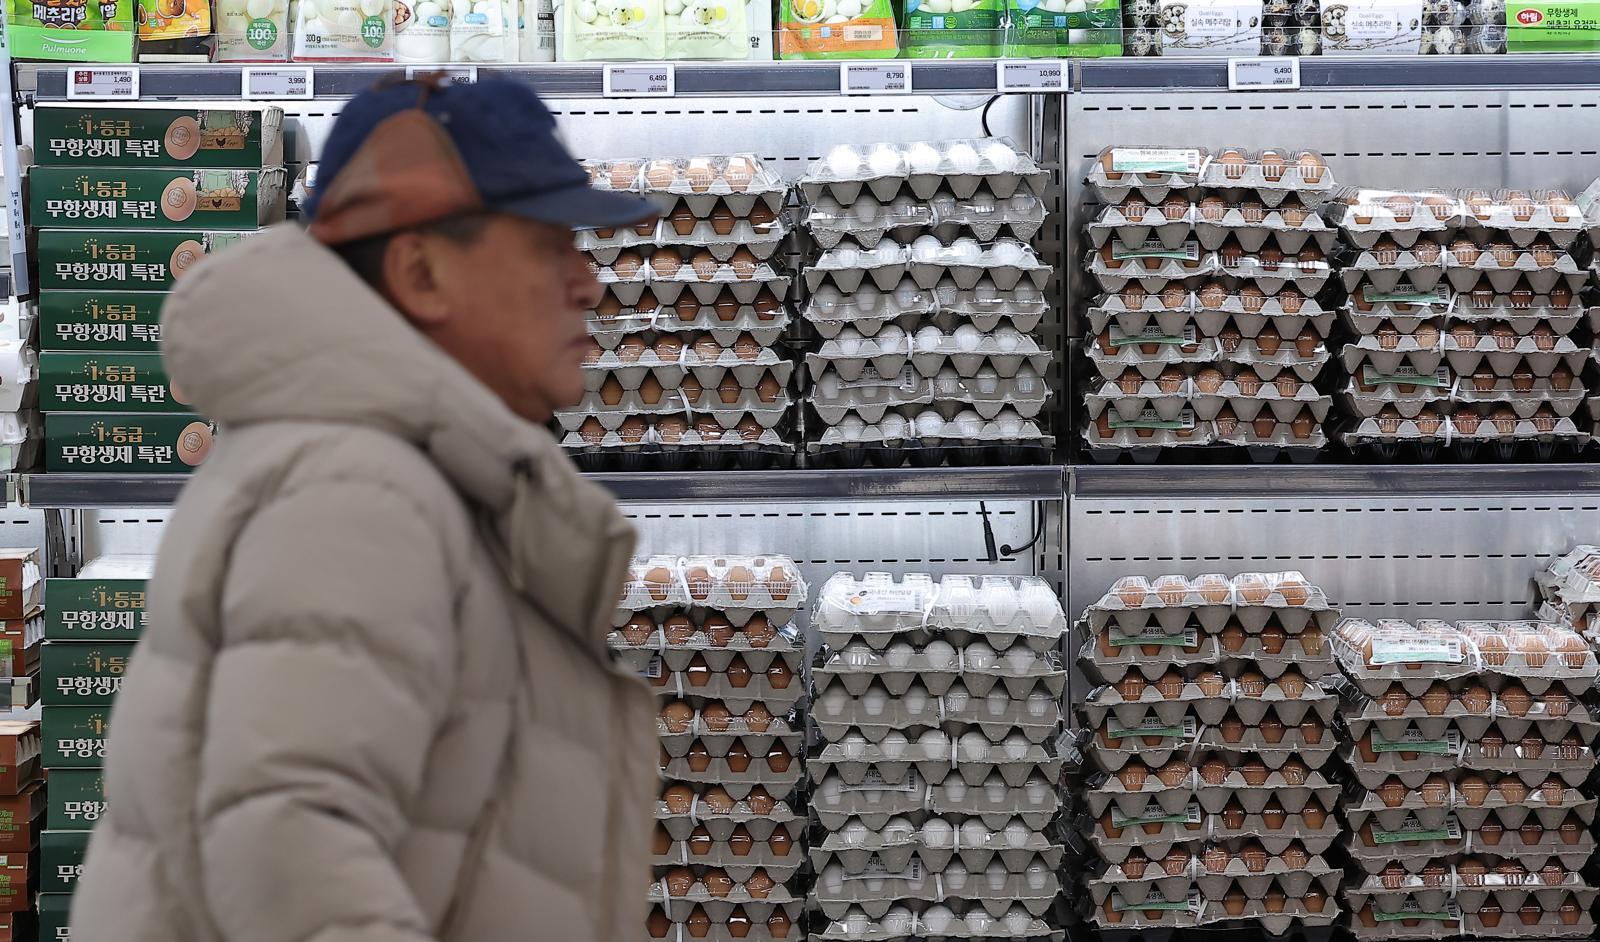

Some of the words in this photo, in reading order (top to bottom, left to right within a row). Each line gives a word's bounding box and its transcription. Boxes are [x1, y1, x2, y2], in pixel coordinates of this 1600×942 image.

[33, 4, 86, 22] 메추리알
[1520, 12, 1538, 22] 하림
[1547, 8, 1578, 18] 무항생제
[248, 28, 276, 41] 100%
[42, 43, 87, 54] Pulmuone
[1274, 67, 1292, 75] 6,490
[85, 118, 131, 137] 1+등급
[49, 138, 120, 157] 무항생제
[125, 139, 161, 158] 특란
[81, 180, 128, 198] 1+등급
[46, 199, 117, 219] 무항생제
[121, 200, 158, 219] 특란
[91, 243, 136, 261] 1+등급
[55, 262, 126, 281] 무항생제
[130, 263, 166, 281] 특란
[91, 304, 137, 321] 1+등급
[55, 323, 126, 342] 무항생제
[131, 324, 164, 342] 특란
[91, 365, 136, 382] 1+등급
[55, 384, 126, 403] 무항생제
[130, 384, 166, 403] 특란
[97, 426, 143, 443] 1+등급
[61, 445, 133, 464] 무항생제
[137, 446, 173, 464] 특란
[98, 591, 145, 609] 1+등급
[61, 611, 135, 630] 무항생제
[93, 657, 128, 674] 1+등
[57, 738, 109, 758] 무항생
